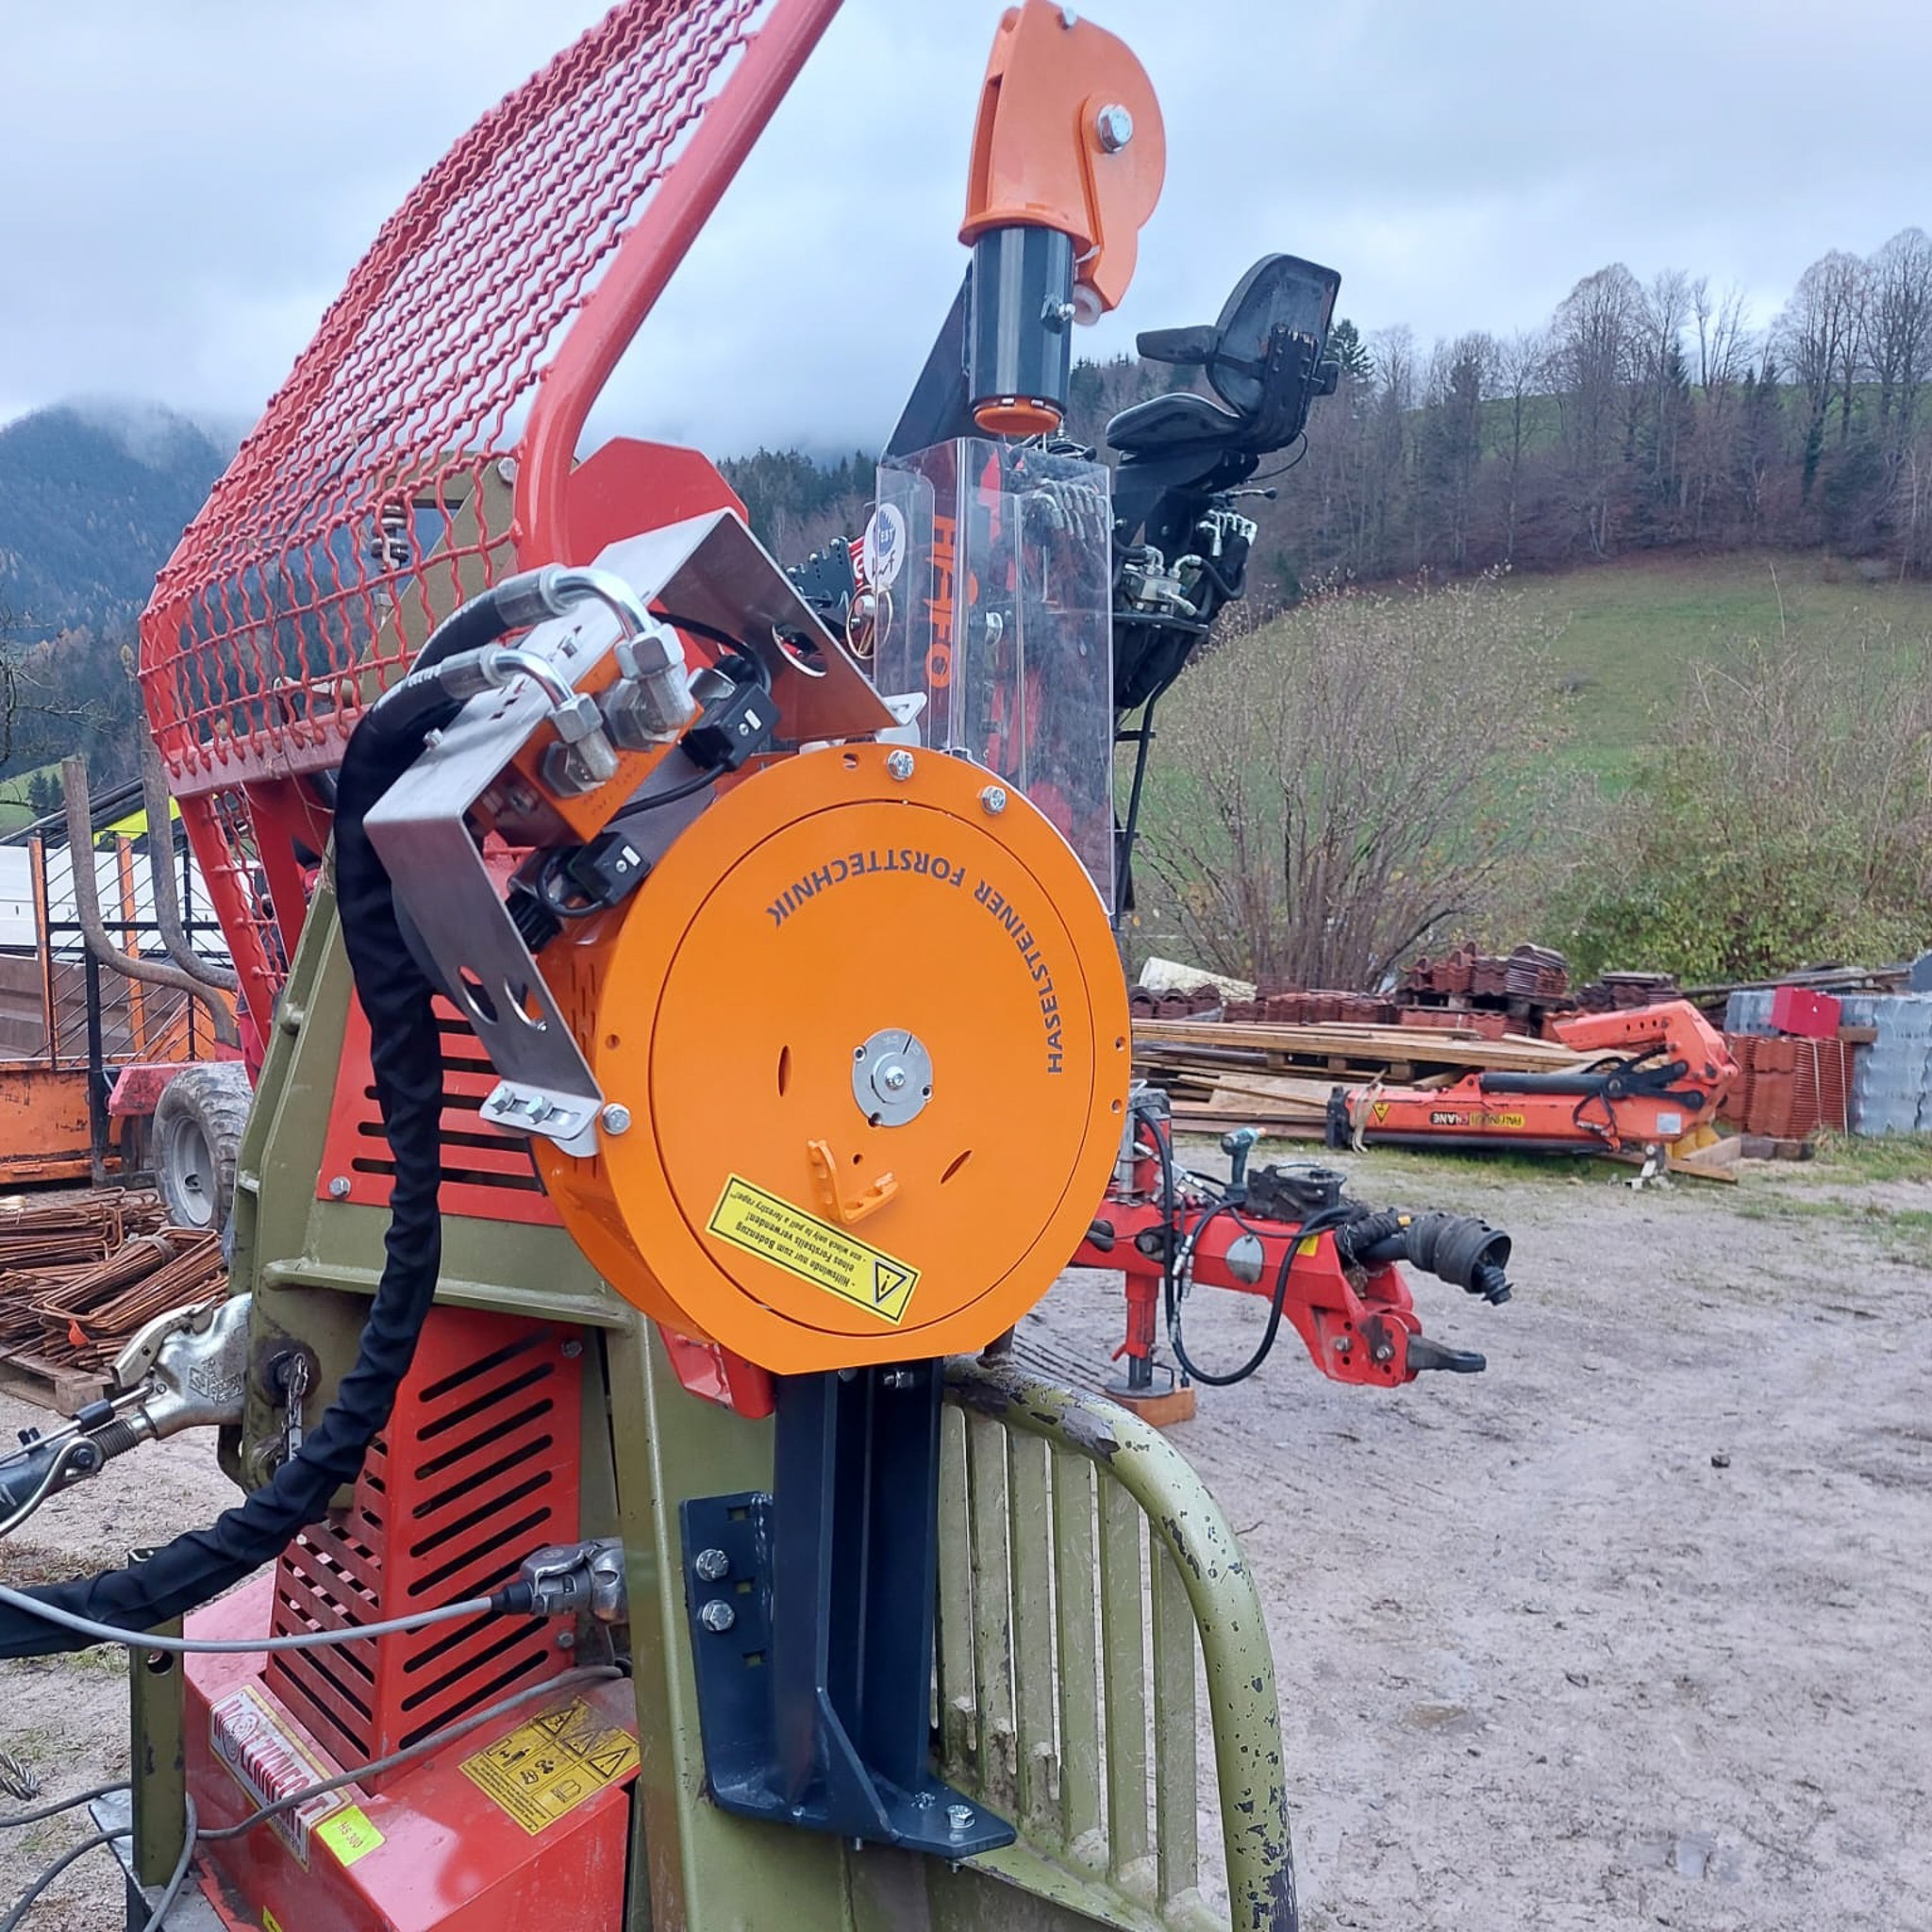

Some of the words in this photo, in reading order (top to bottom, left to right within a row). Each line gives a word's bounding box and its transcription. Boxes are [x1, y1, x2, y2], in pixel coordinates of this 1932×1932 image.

[765, 848, 967, 927] FORSTTECHNIK
[973, 877, 1064, 1074] HASELSTEINER
[756, 1201, 783, 1222] forestry
[745, 1211, 793, 1241] verwenden!
[789, 1221, 805, 1231] pull
[805, 1227, 813, 1237] to
[735, 1221, 775, 1250] Bodenzug
[813, 1231, 828, 1243] only
[776, 1243, 793, 1257] zum
[794, 1236, 833, 1262] Forstseils
[828, 1241, 849, 1255] winch
[794, 1253, 808, 1264] nur
[833, 1256, 855, 1272] eines
[809, 1259, 850, 1287] Hilfswinde
